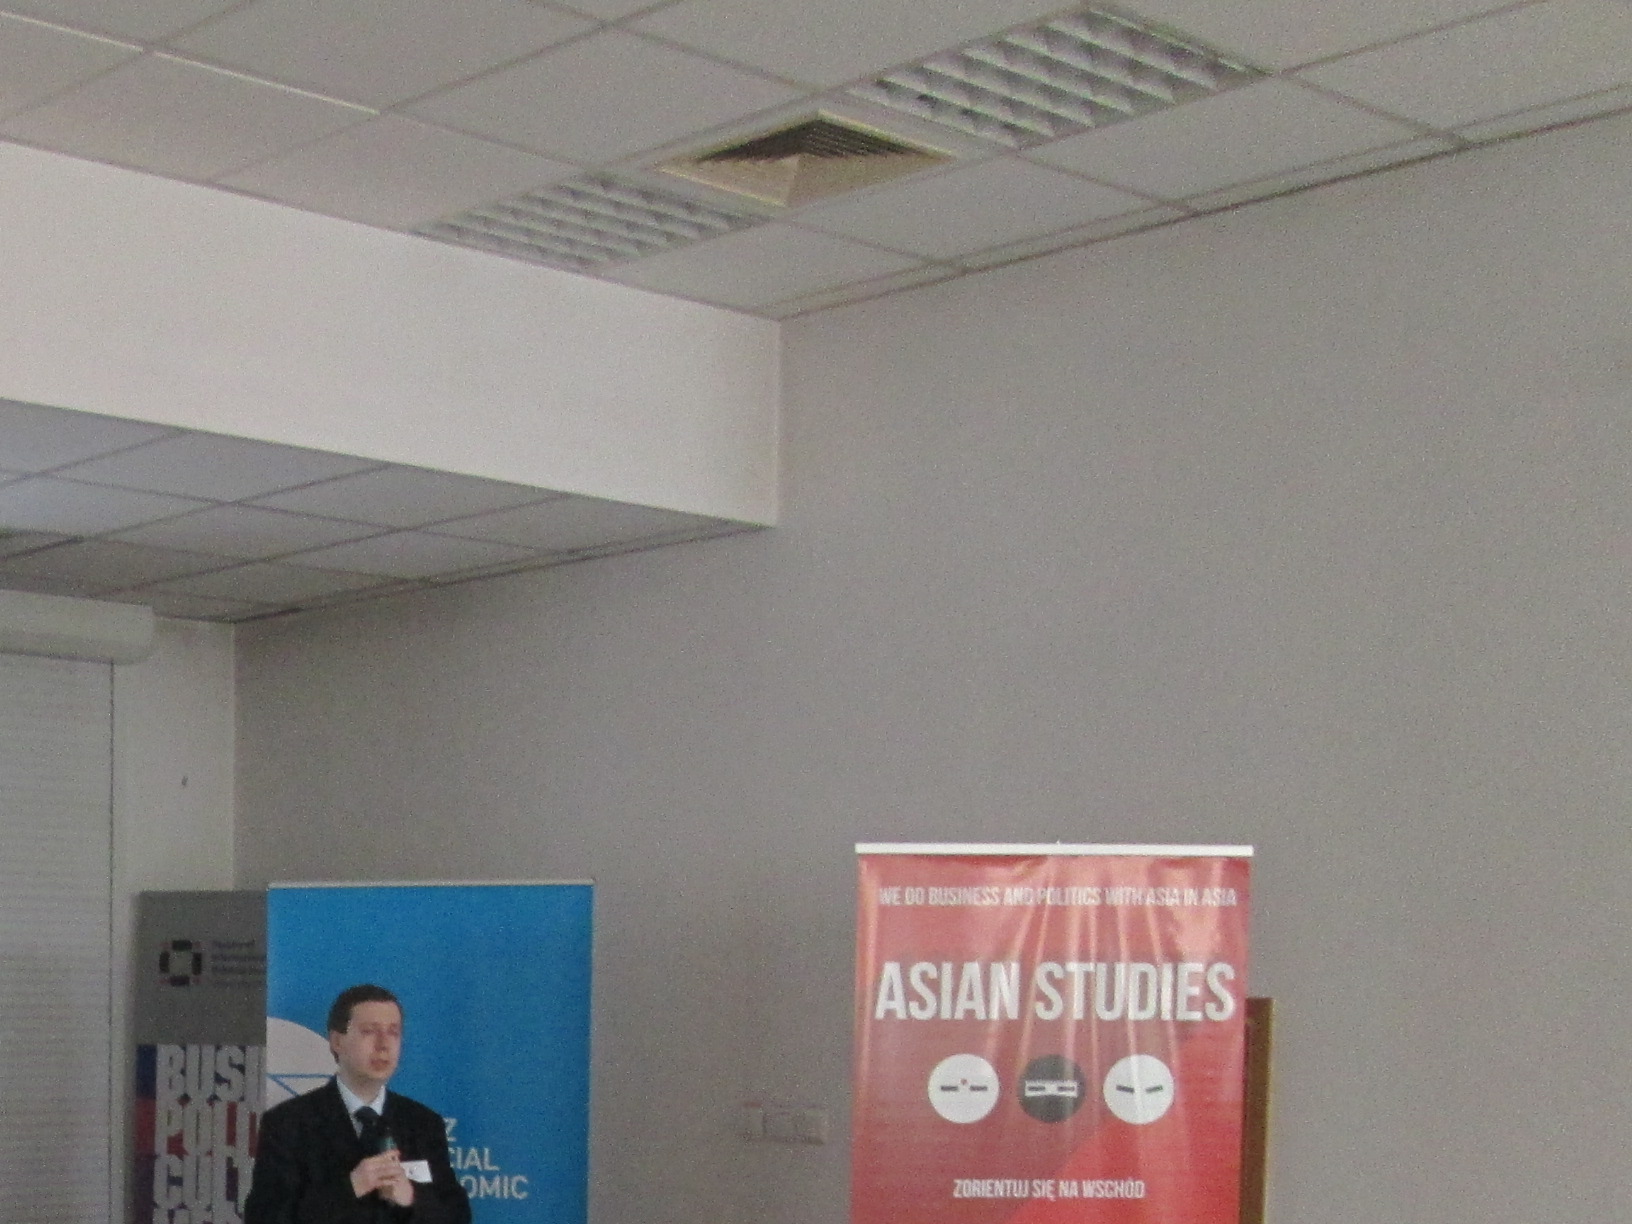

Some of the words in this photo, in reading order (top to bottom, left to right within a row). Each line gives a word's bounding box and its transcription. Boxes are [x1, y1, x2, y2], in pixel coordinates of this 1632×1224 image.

[879, 886, 901, 906] WE
[905, 886, 924, 906] DO
[929, 886, 999, 906] BUSINESS
[1004, 886, 1033, 906] AND
[1036, 886, 1100, 906] POLITICS
[1146, 887, 1179, 906] ASIA
[1202, 887, 1237, 906] ASIA
[875, 961, 1020, 1021] ASIAN
[1035, 961, 1236, 1021] STUDIES
[953, 1179, 1028, 1198] ZORIENTUJ
[1033, 1179, 1056, 1201] SIĘ
[1059, 1180, 1079, 1198] NA
[1082, 1177, 1145, 1199] WSCHÓD
